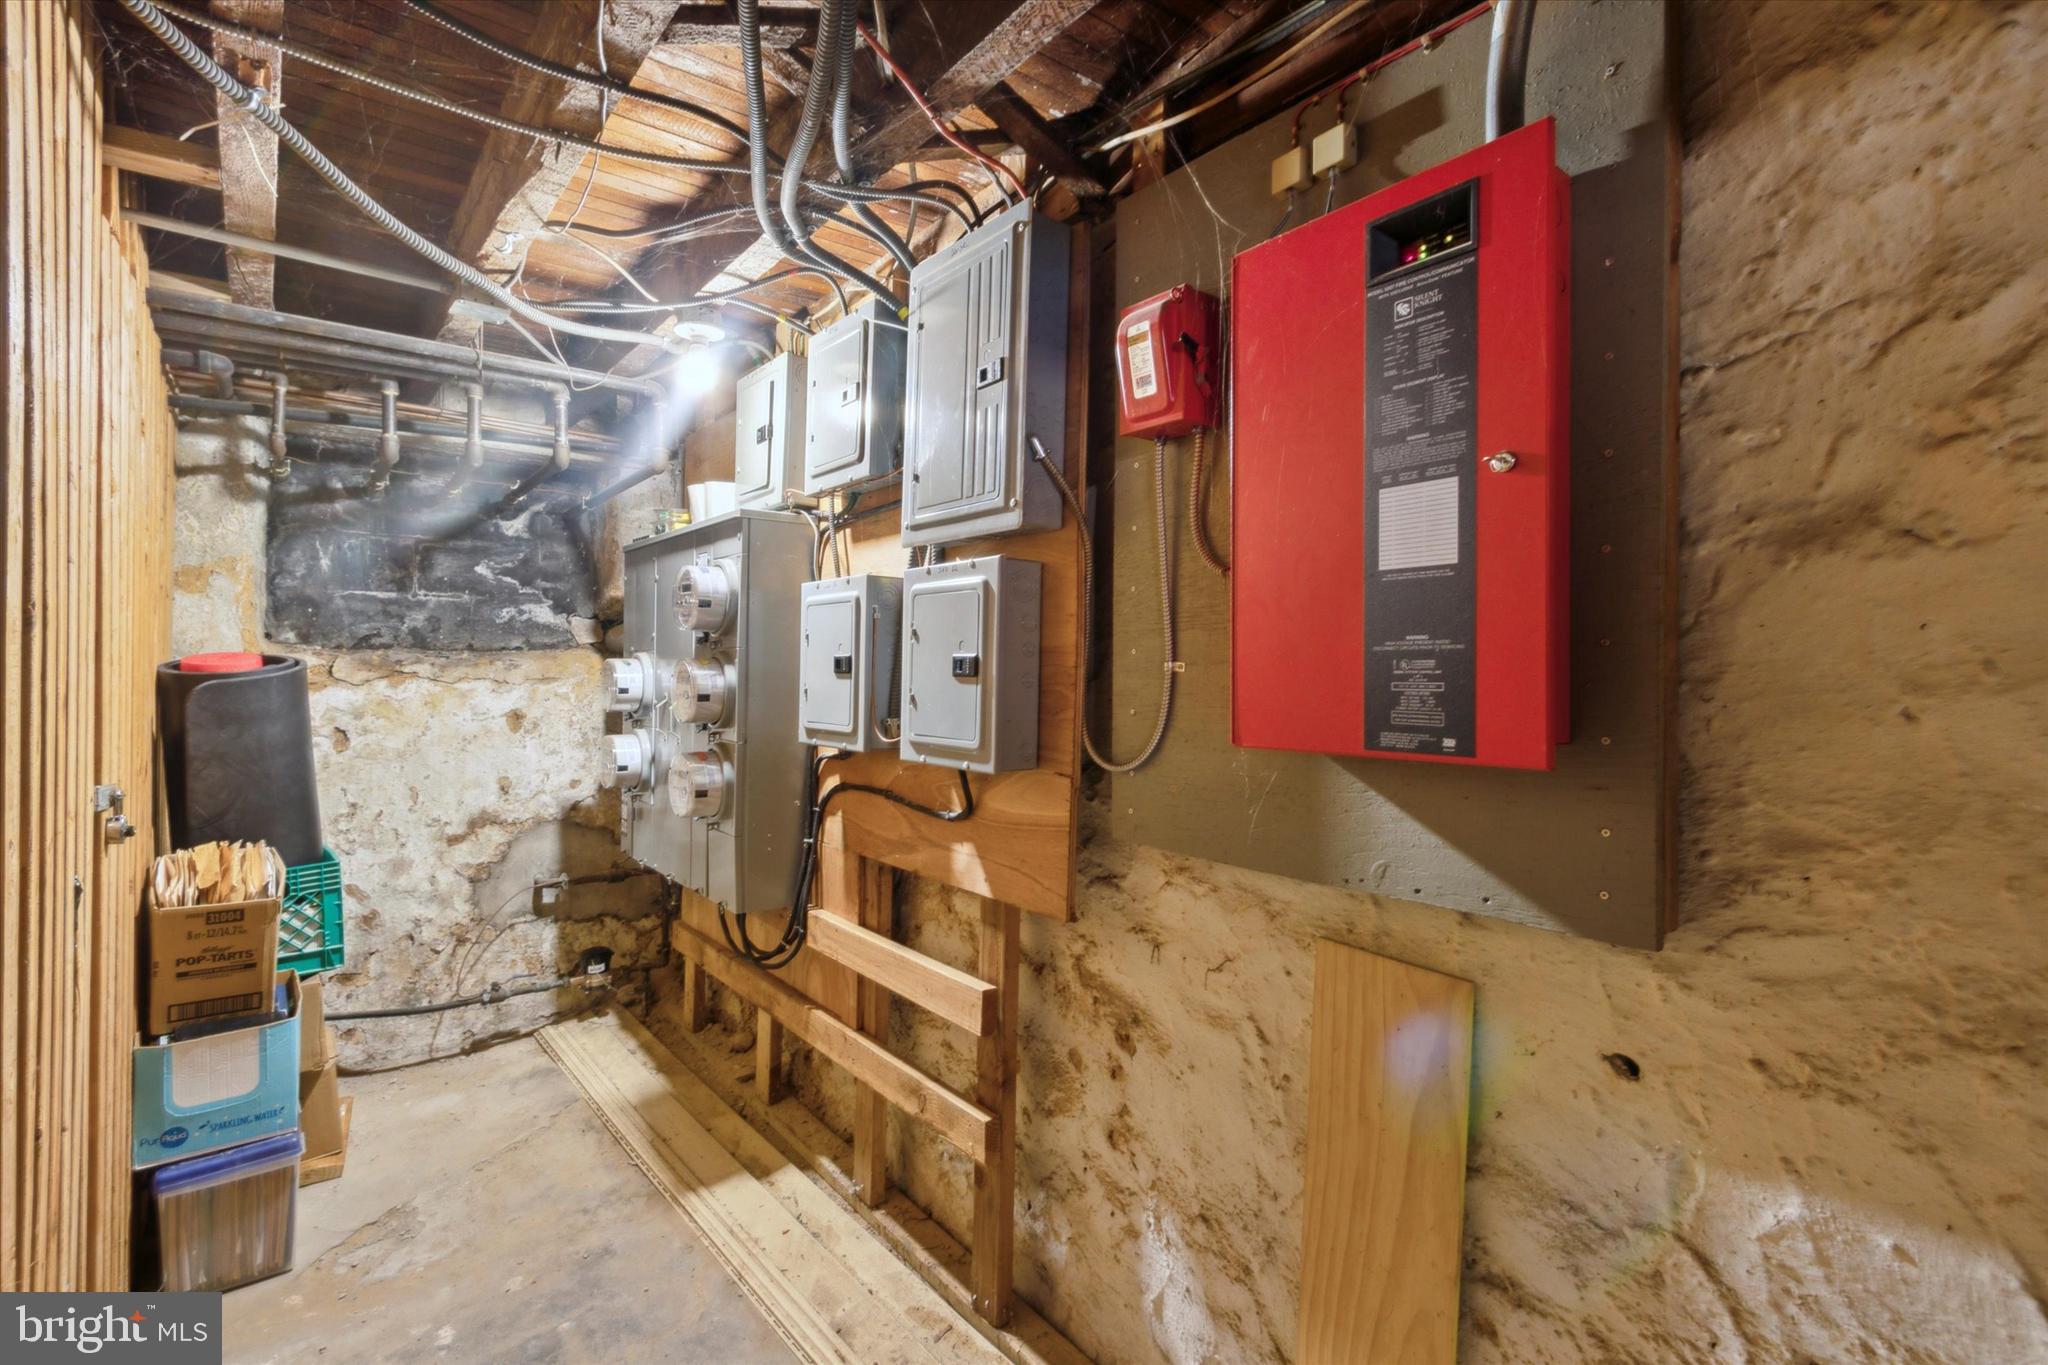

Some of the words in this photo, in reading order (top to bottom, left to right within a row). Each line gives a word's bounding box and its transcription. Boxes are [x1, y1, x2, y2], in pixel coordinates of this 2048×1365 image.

[1415, 288, 1440, 301] SILENT
[1415, 294, 1444, 309] KNIGHT
[175, 949, 255, 967] POP-TARTS
[209, 1115, 252, 1133] SPARKLING
[254, 1109, 279, 1122] WATER
